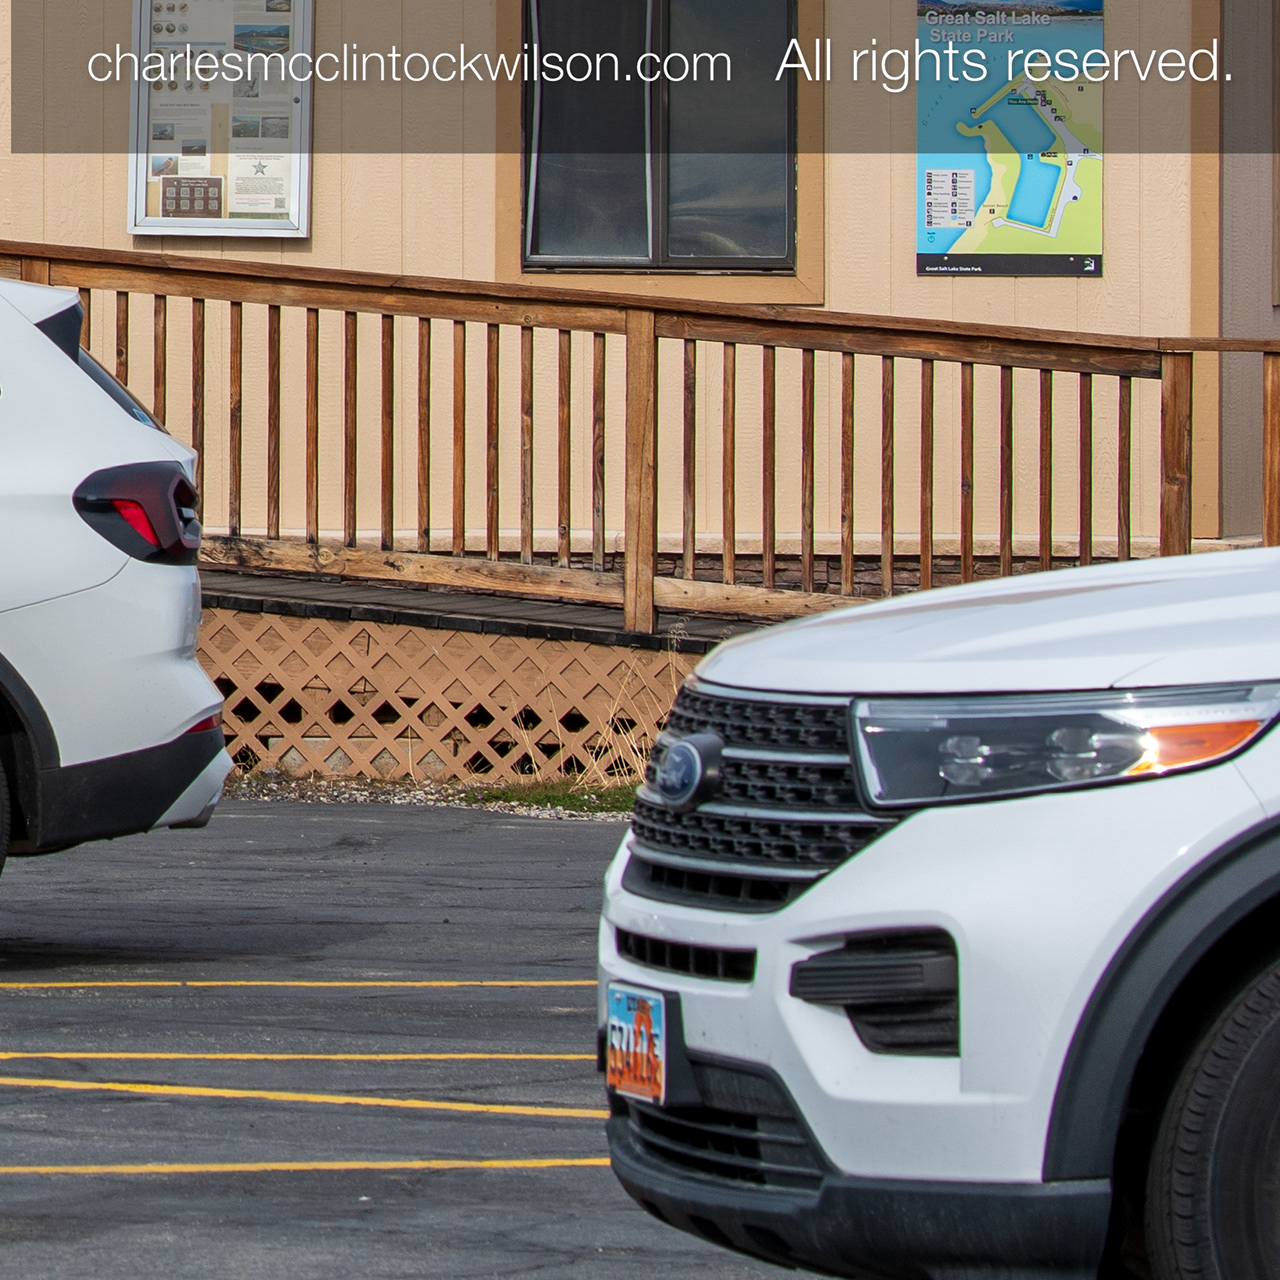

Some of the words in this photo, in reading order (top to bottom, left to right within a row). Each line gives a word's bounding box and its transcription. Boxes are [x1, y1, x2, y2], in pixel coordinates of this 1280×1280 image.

[925, 10, 970, 25] Great
[975, 10, 1007, 25] Salt
[1012, 10, 1051, 25] Lake
[930, 28, 972, 42] State
[977, 28, 1014, 42] Park
